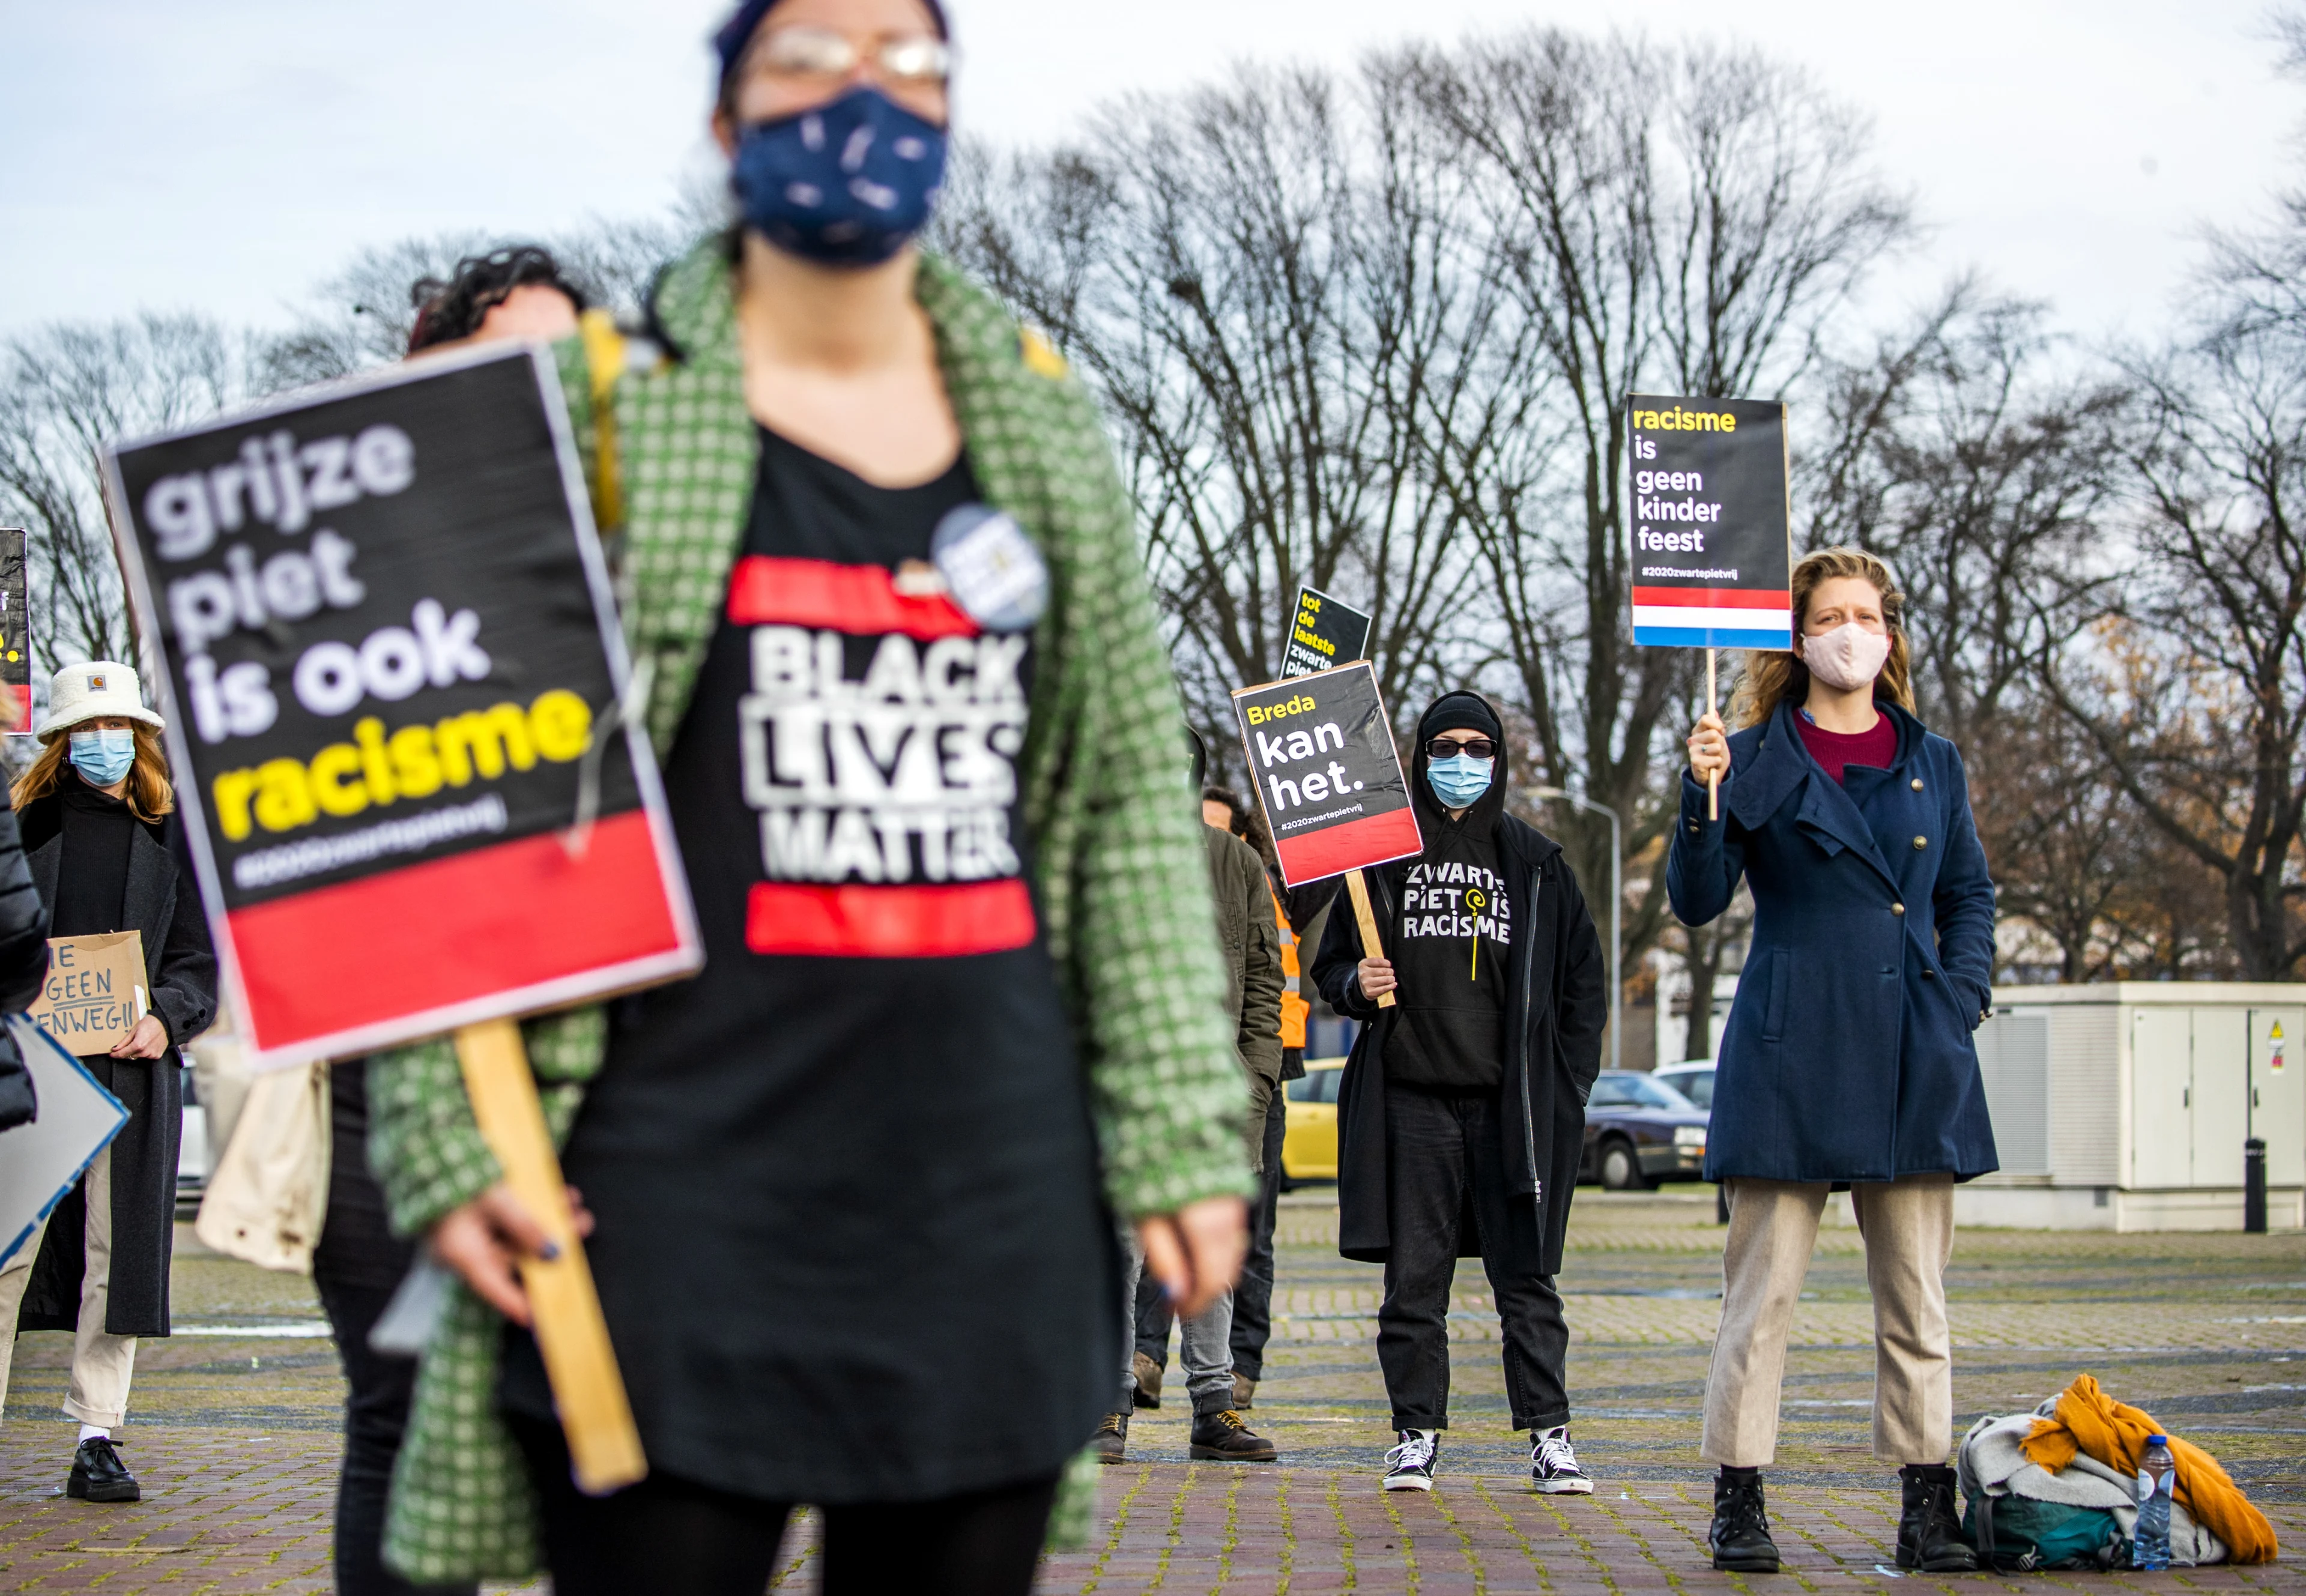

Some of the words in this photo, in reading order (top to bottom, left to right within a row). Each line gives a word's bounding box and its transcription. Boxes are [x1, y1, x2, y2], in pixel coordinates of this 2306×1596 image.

[1633, 406, 1737, 433] racisme
[1634, 435, 1657, 460] is
[145, 424, 414, 560] grijze
[1636, 471, 1702, 495] geen
[1637, 495, 1722, 522] kinder
[1637, 525, 1704, 552] feest
[1641, 566, 1738, 581] #2020zwartepietvrij
[168, 530, 364, 654] piet
[1302, 593, 1321, 613] tot
[1298, 610, 1315, 628] de
[1294, 624, 1336, 656] laatste
[187, 655, 278, 743] is
[294, 599, 491, 716] ook
[751, 626, 1026, 700] BLACK
[1291, 644, 1332, 670] zwarte
[1247, 695, 1316, 725] Breda
[747, 705, 1027, 799] LIVES
[1255, 722, 1345, 768] kan
[213, 689, 592, 841] racisme
[1268, 761, 1364, 811] het.
[1281, 803, 1363, 831] #2020zwartepietvrij
[760, 808, 1020, 882] MATTER
[49, 944, 75, 970] IE
[46, 968, 111, 1001] GEEN
[37, 1001, 133, 1035] ENWEG!!
